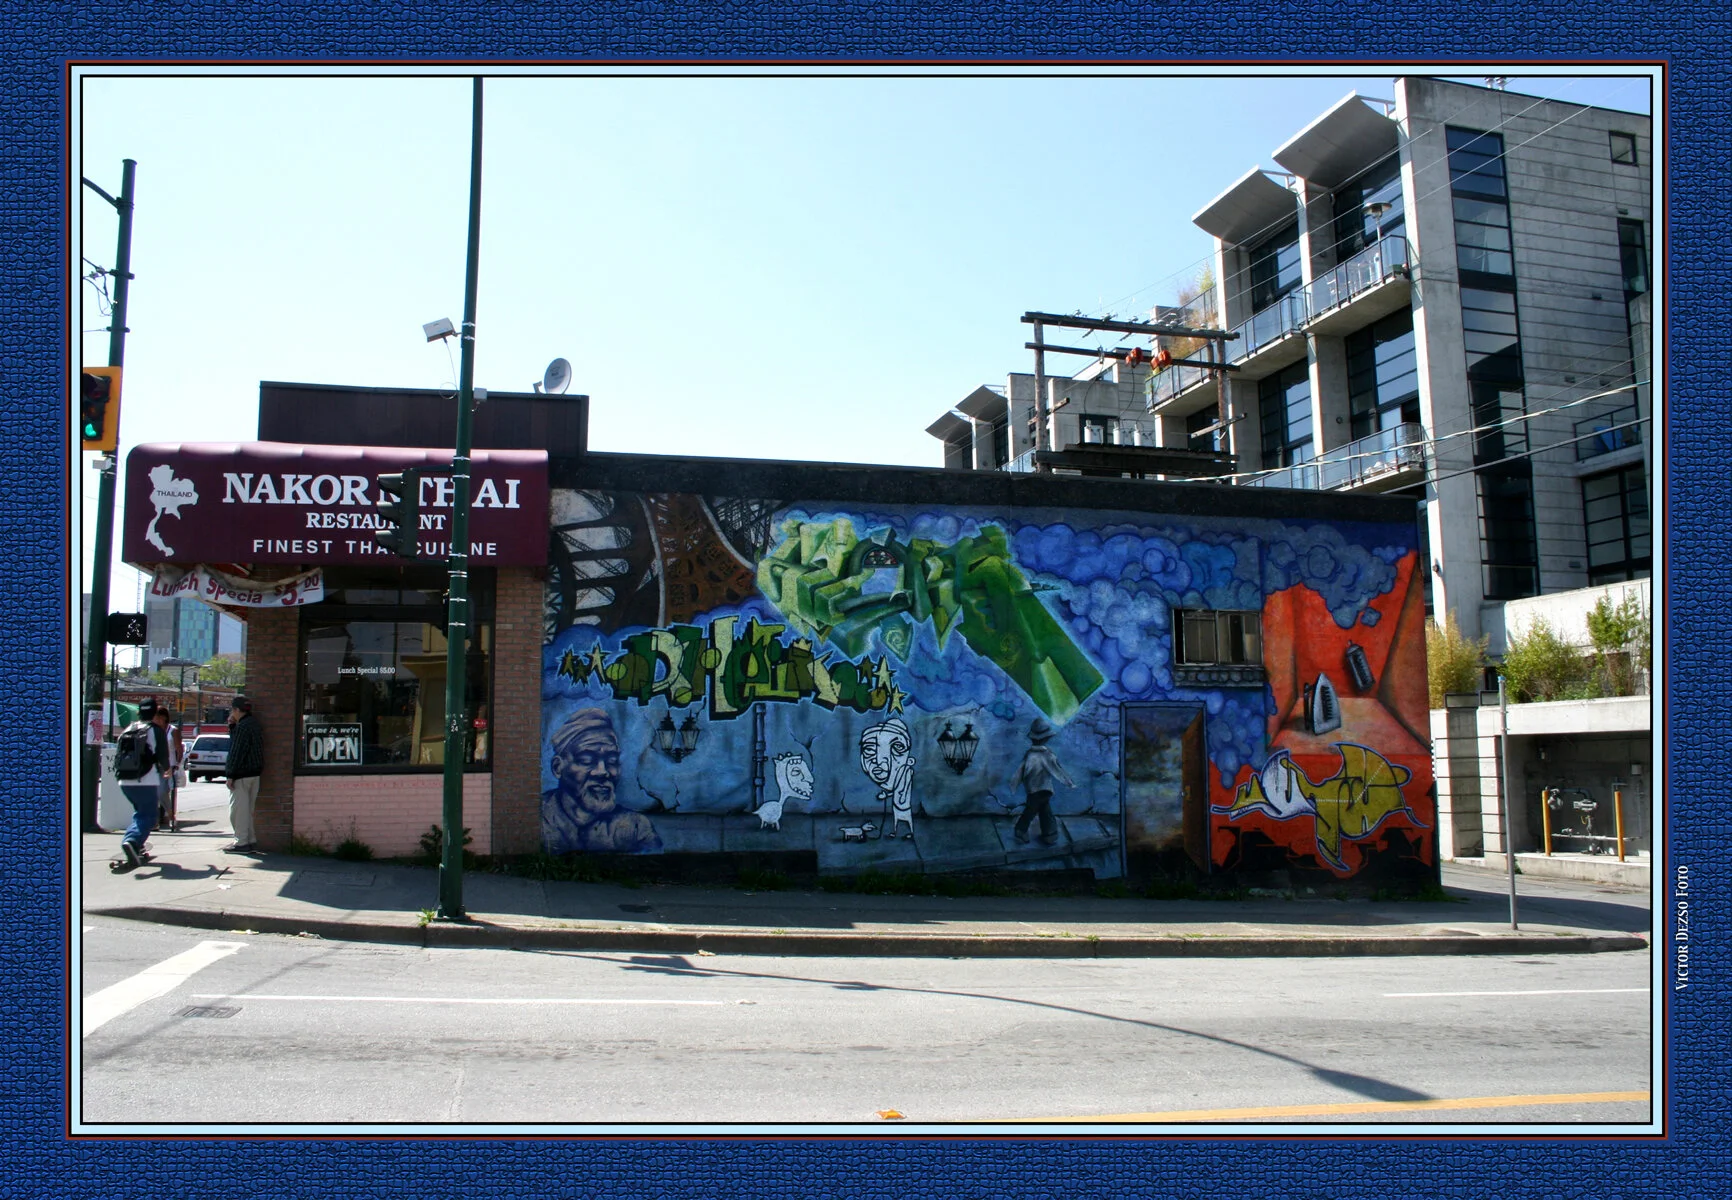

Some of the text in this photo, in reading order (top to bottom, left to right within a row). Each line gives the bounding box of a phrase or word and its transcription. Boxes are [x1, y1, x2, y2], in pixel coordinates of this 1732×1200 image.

[156, 490, 193, 498] THAILAND
[305, 512, 446, 530] RESTAUNT
[252, 539, 333, 554] FINEST
[345, 540, 396, 555] THA
[151, 572, 199, 597] Lunch
[337, 666, 356, 674] Lunch
[357, 666, 379, 676] Special
[308, 726, 327, 734] Come
[309, 736, 359, 761] OPEN
